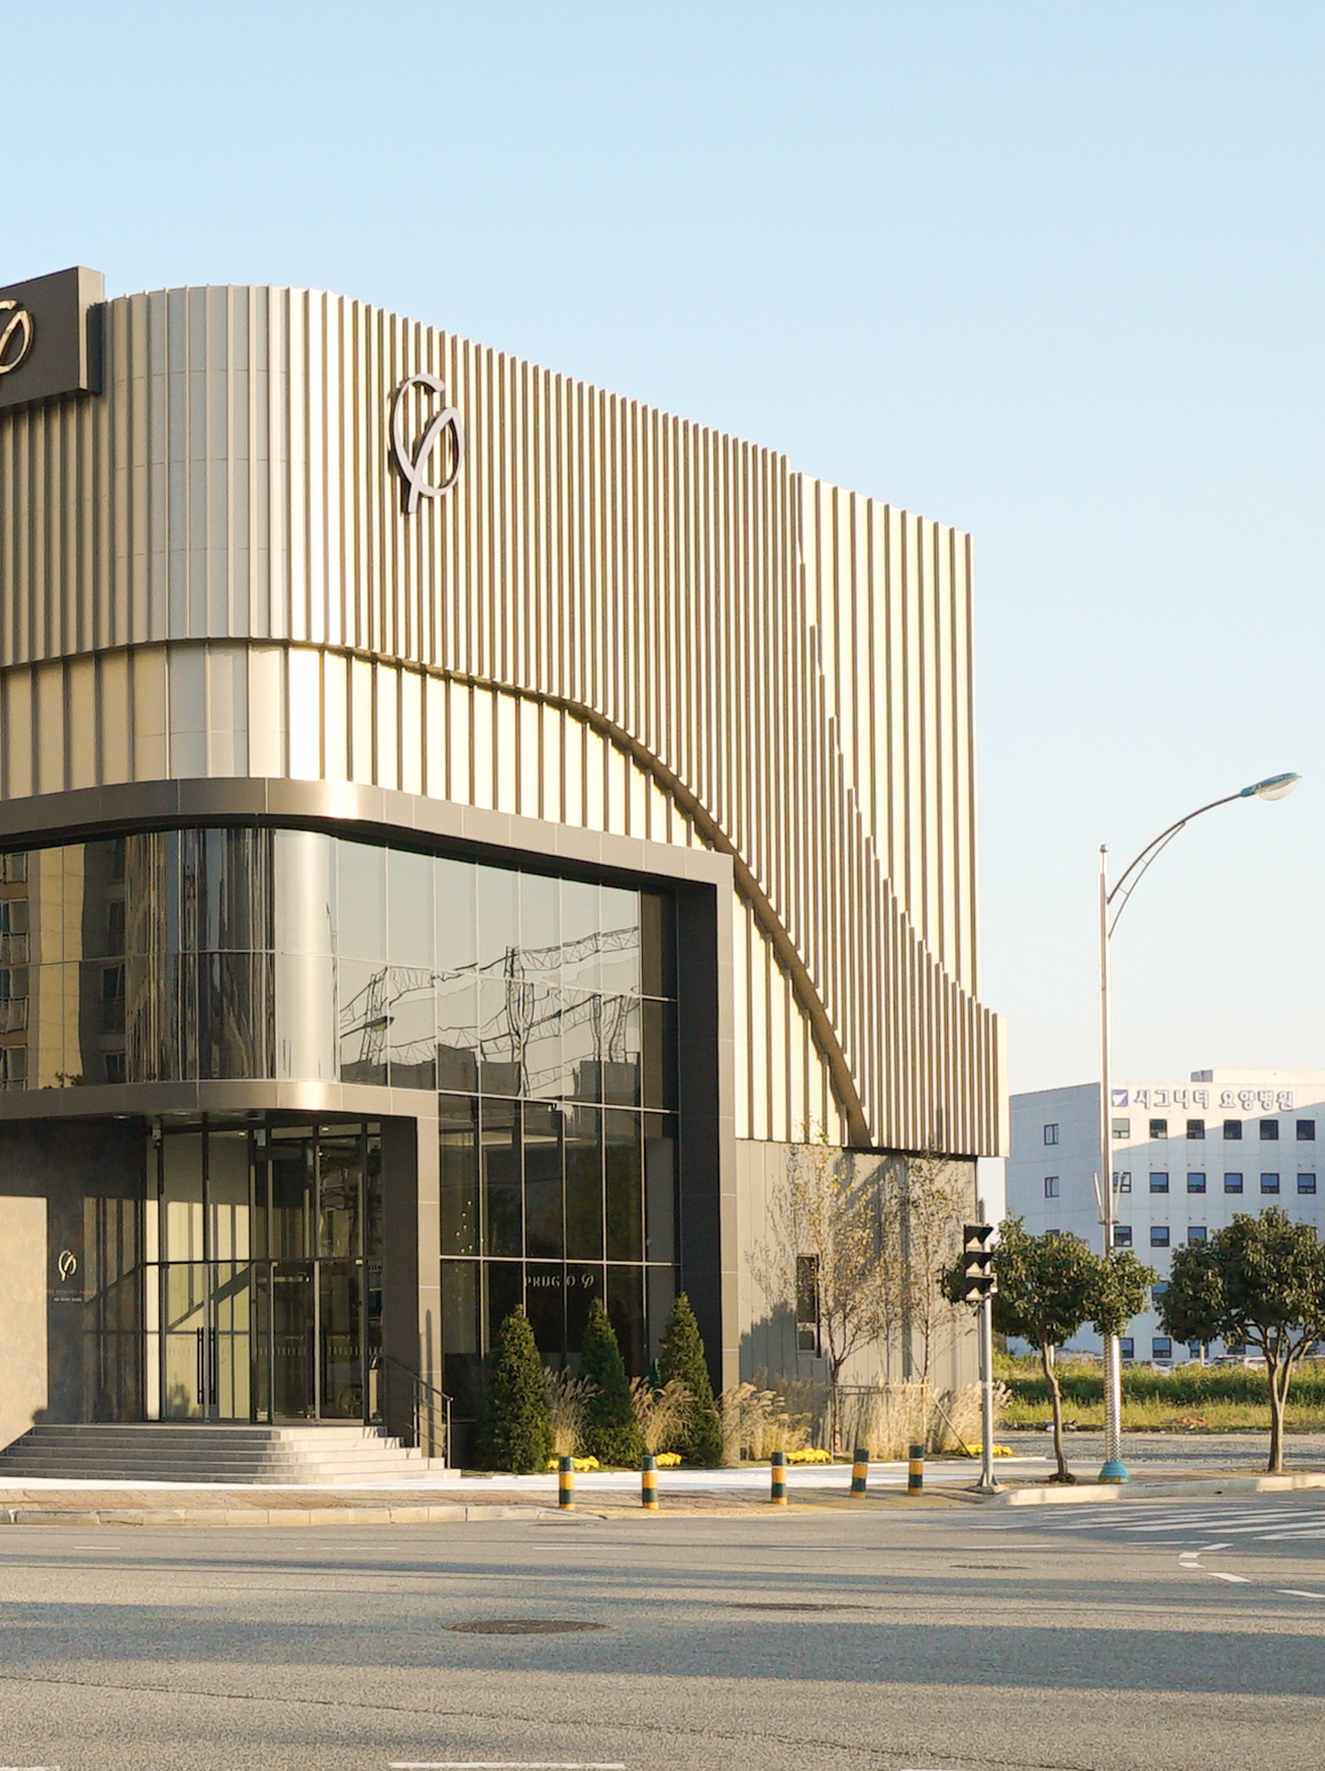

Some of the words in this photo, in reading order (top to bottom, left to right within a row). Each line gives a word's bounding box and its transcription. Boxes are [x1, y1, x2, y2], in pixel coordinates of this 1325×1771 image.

[1133, 1089, 1210, 1110] 시그니티
[1218, 1089, 1294, 1112] 요양병원
[524, 1275, 576, 1288] PRUGO
